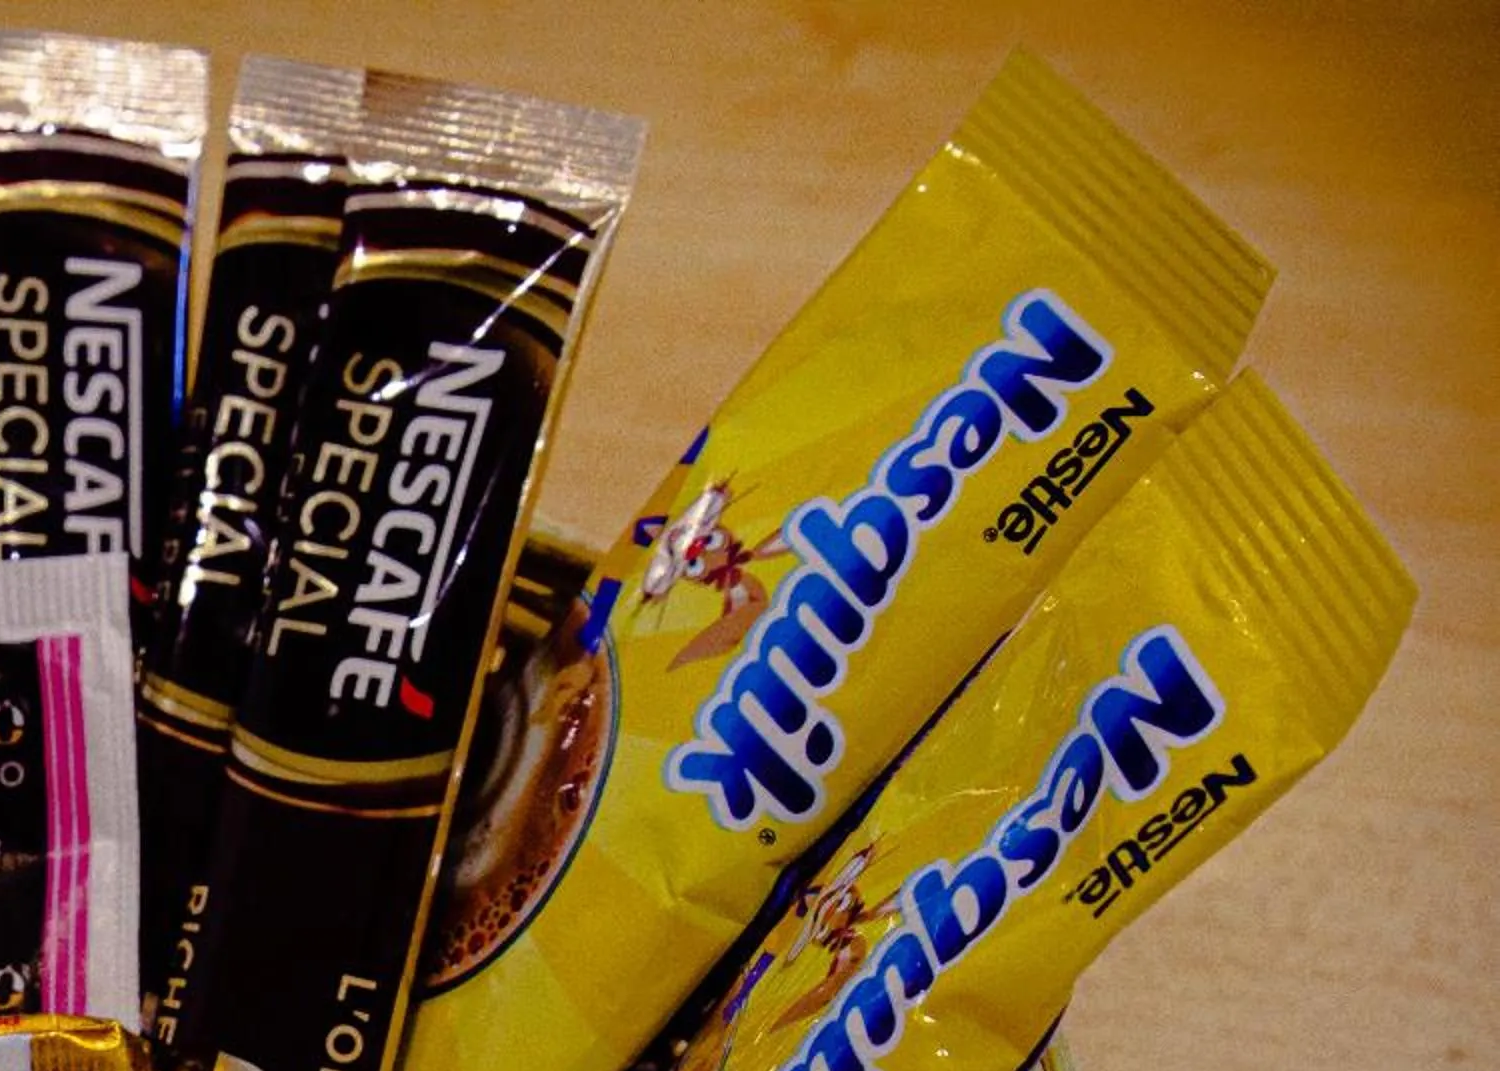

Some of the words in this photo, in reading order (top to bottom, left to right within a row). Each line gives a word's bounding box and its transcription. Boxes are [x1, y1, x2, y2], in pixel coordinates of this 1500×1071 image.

[63, 257, 143, 560] NESCAF
[179, 305, 296, 606] SPECIAL
[267, 352, 401, 657] SPECIAL
[666, 291, 1112, 828] Nesquik
[997, 387, 1156, 556] Nestlé
[1077, 754, 1258, 919] Nestlé
